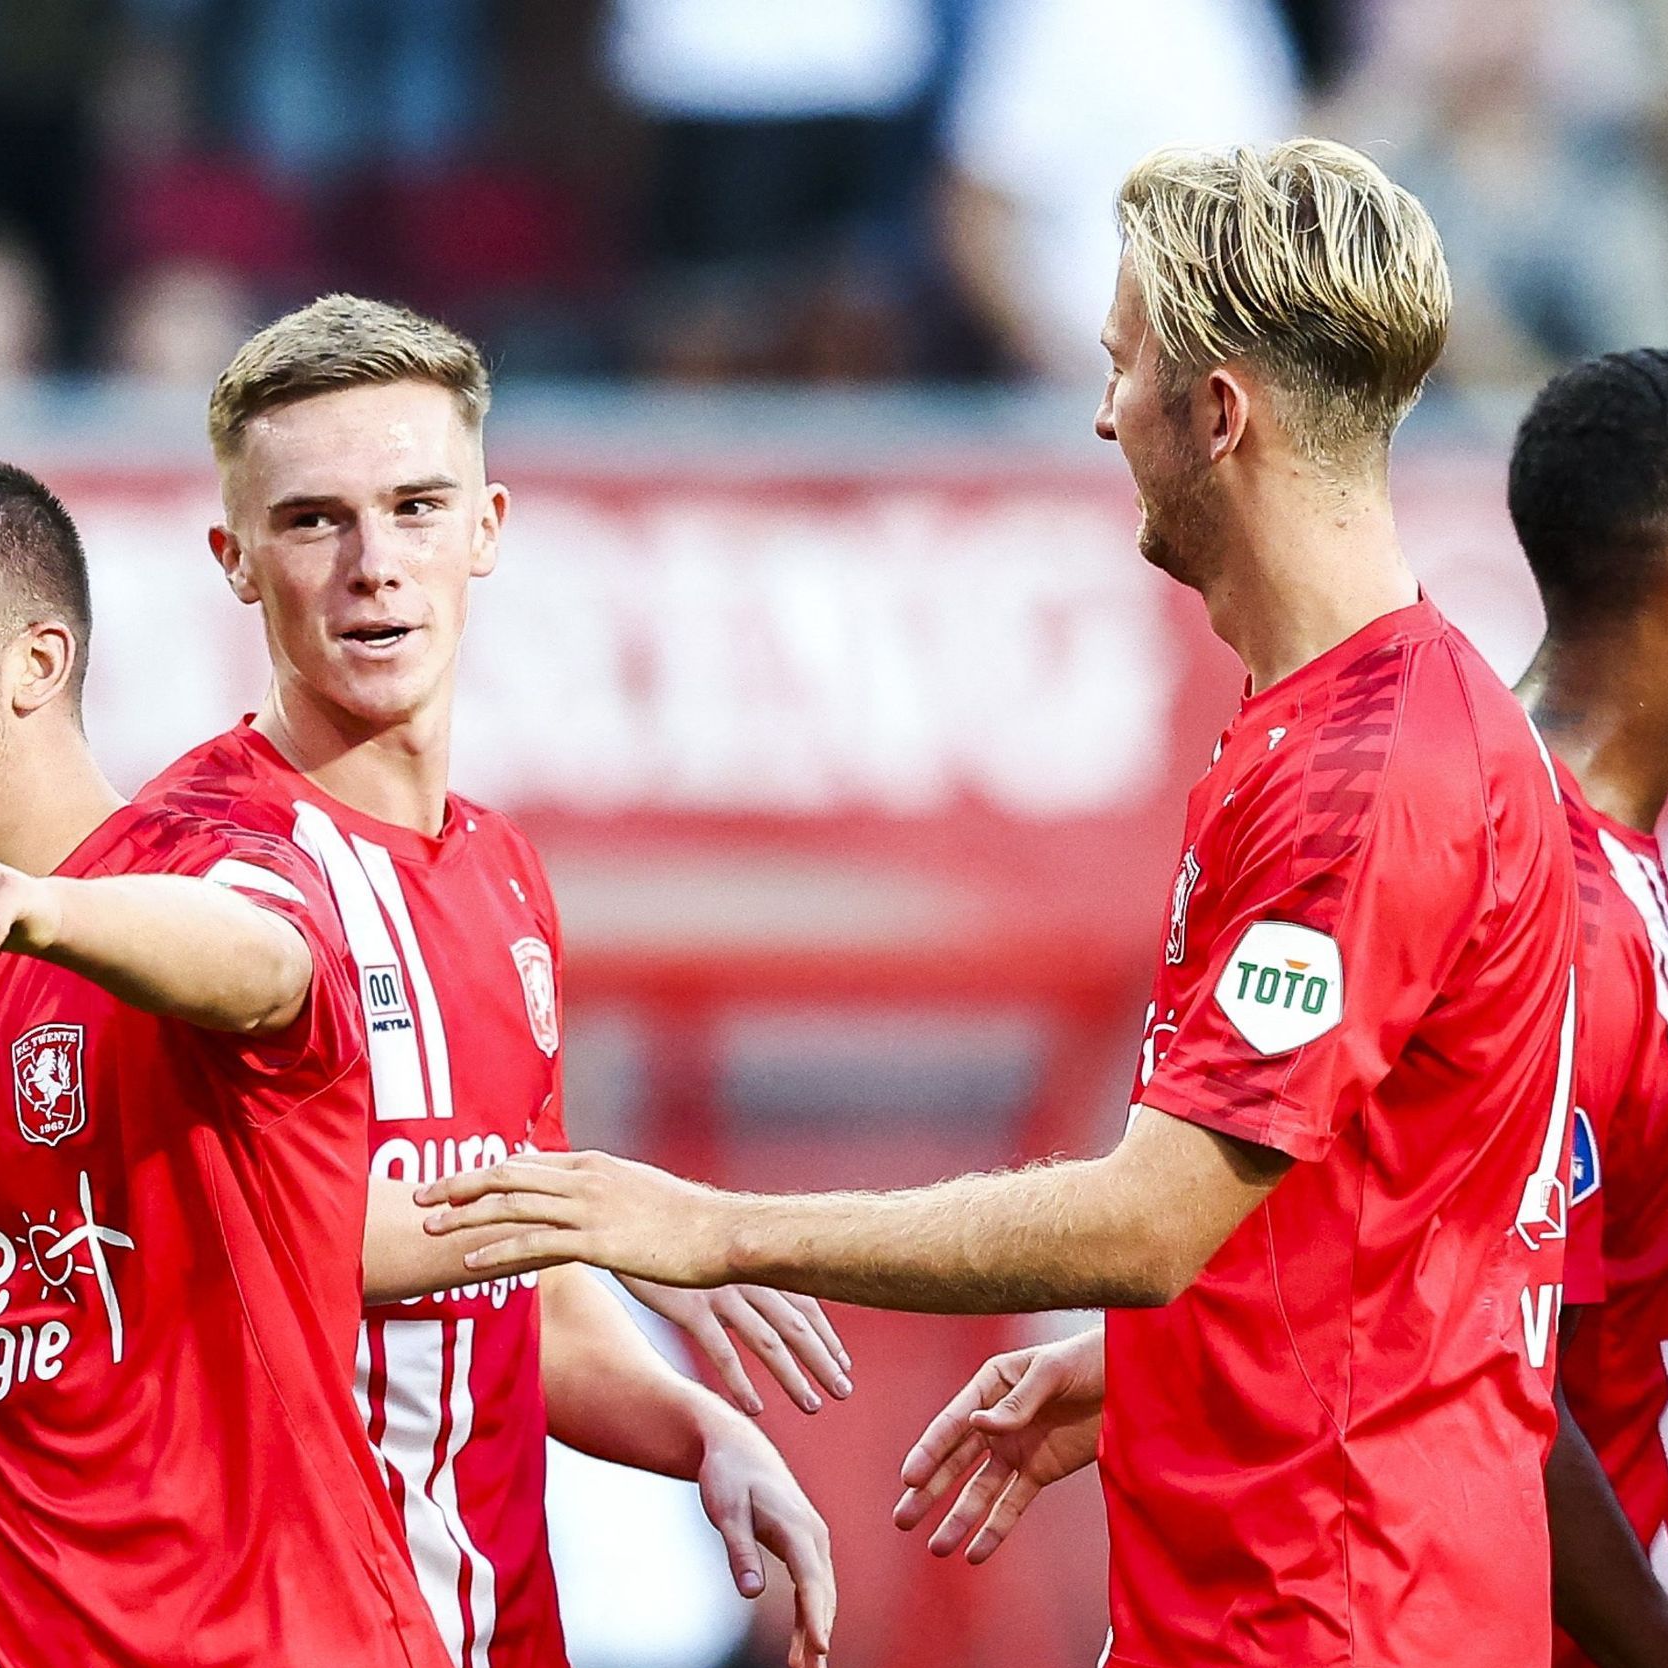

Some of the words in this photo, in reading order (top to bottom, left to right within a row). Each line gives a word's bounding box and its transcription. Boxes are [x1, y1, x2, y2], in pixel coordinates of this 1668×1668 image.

[1237, 961, 1328, 1015] TOTO
[372, 1018, 412, 1032] MEYBA
[31, 1031, 77, 1047] TWENTE
[39, 1120, 65, 1134] 1965
